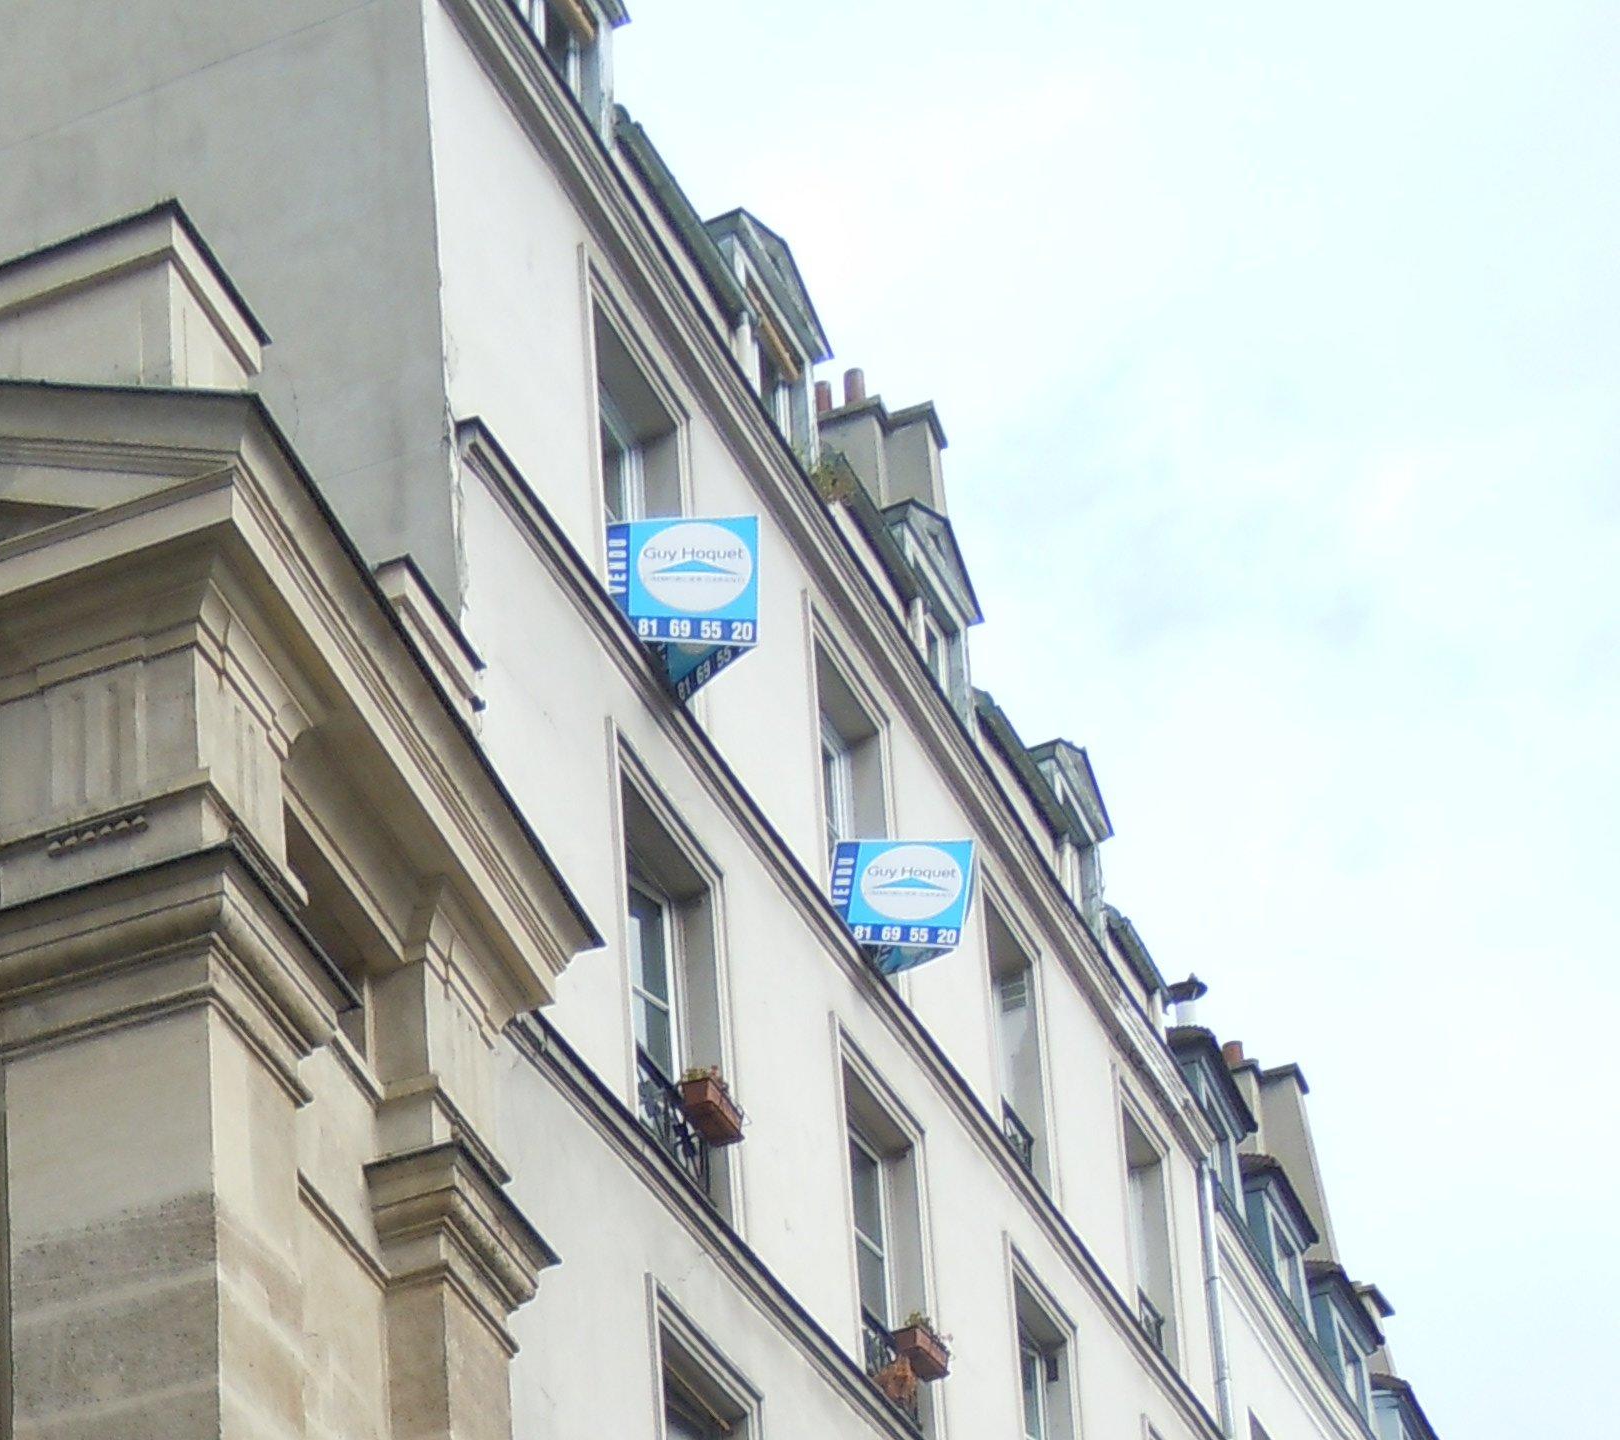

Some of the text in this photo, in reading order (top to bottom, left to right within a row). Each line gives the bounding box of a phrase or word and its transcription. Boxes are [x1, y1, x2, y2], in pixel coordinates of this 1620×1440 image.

[643, 546, 743, 563] Guy Hoquet
[608, 538, 627, 595] VENDU
[638, 618, 753, 640] 81 69 55 20
[867, 865, 957, 880] Guy Hoquet
[853, 924, 957, 944] 81 69 55 20
